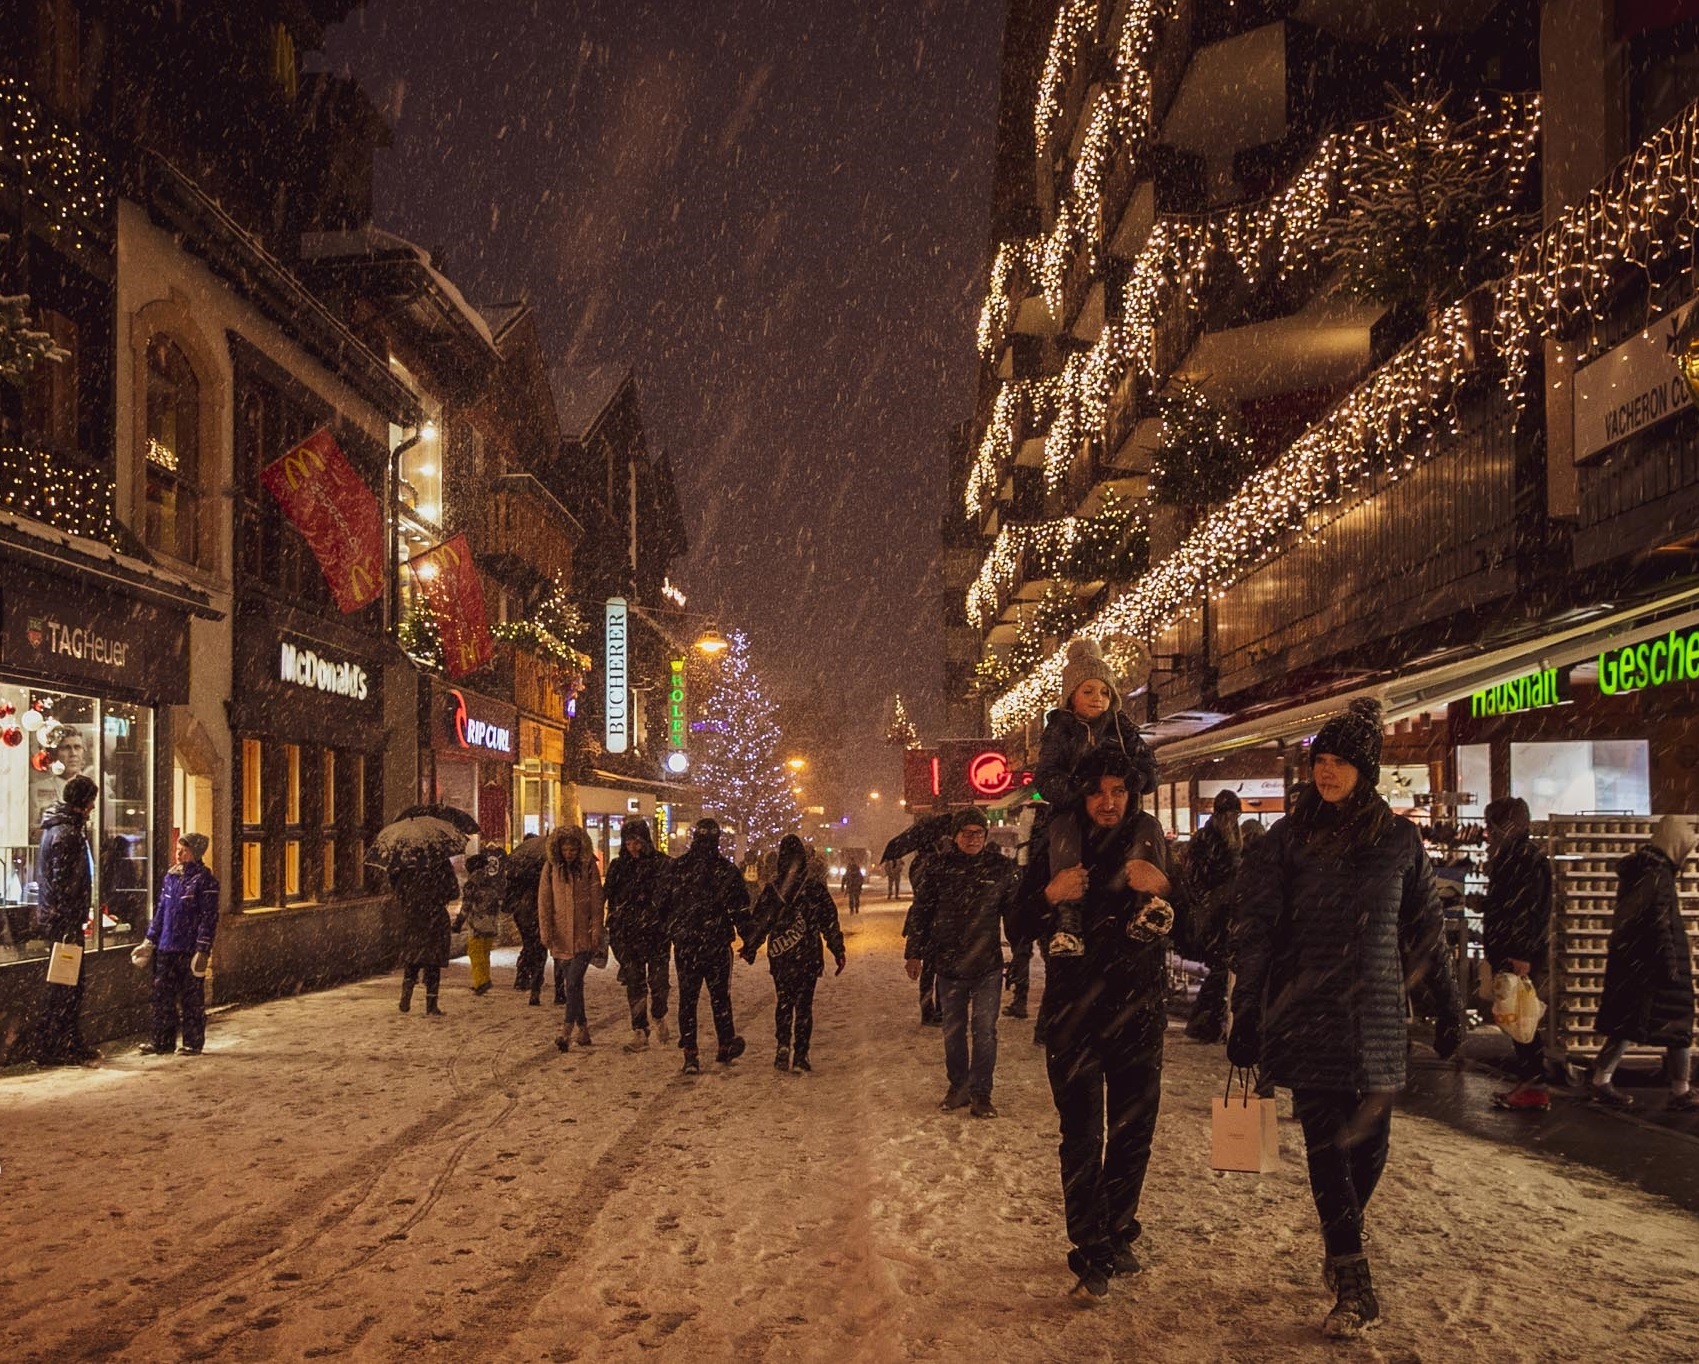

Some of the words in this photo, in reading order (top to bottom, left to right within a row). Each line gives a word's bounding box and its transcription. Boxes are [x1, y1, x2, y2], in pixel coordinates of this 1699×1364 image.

[1604, 382, 1668, 441] VACHERON
[281, 642, 368, 700] McDonald's
[608, 613, 625, 736] BUCHERER
[466, 718, 486, 746] RIP
[485, 722, 511, 752] CURL
[670, 673, 684, 747] ROLEX
